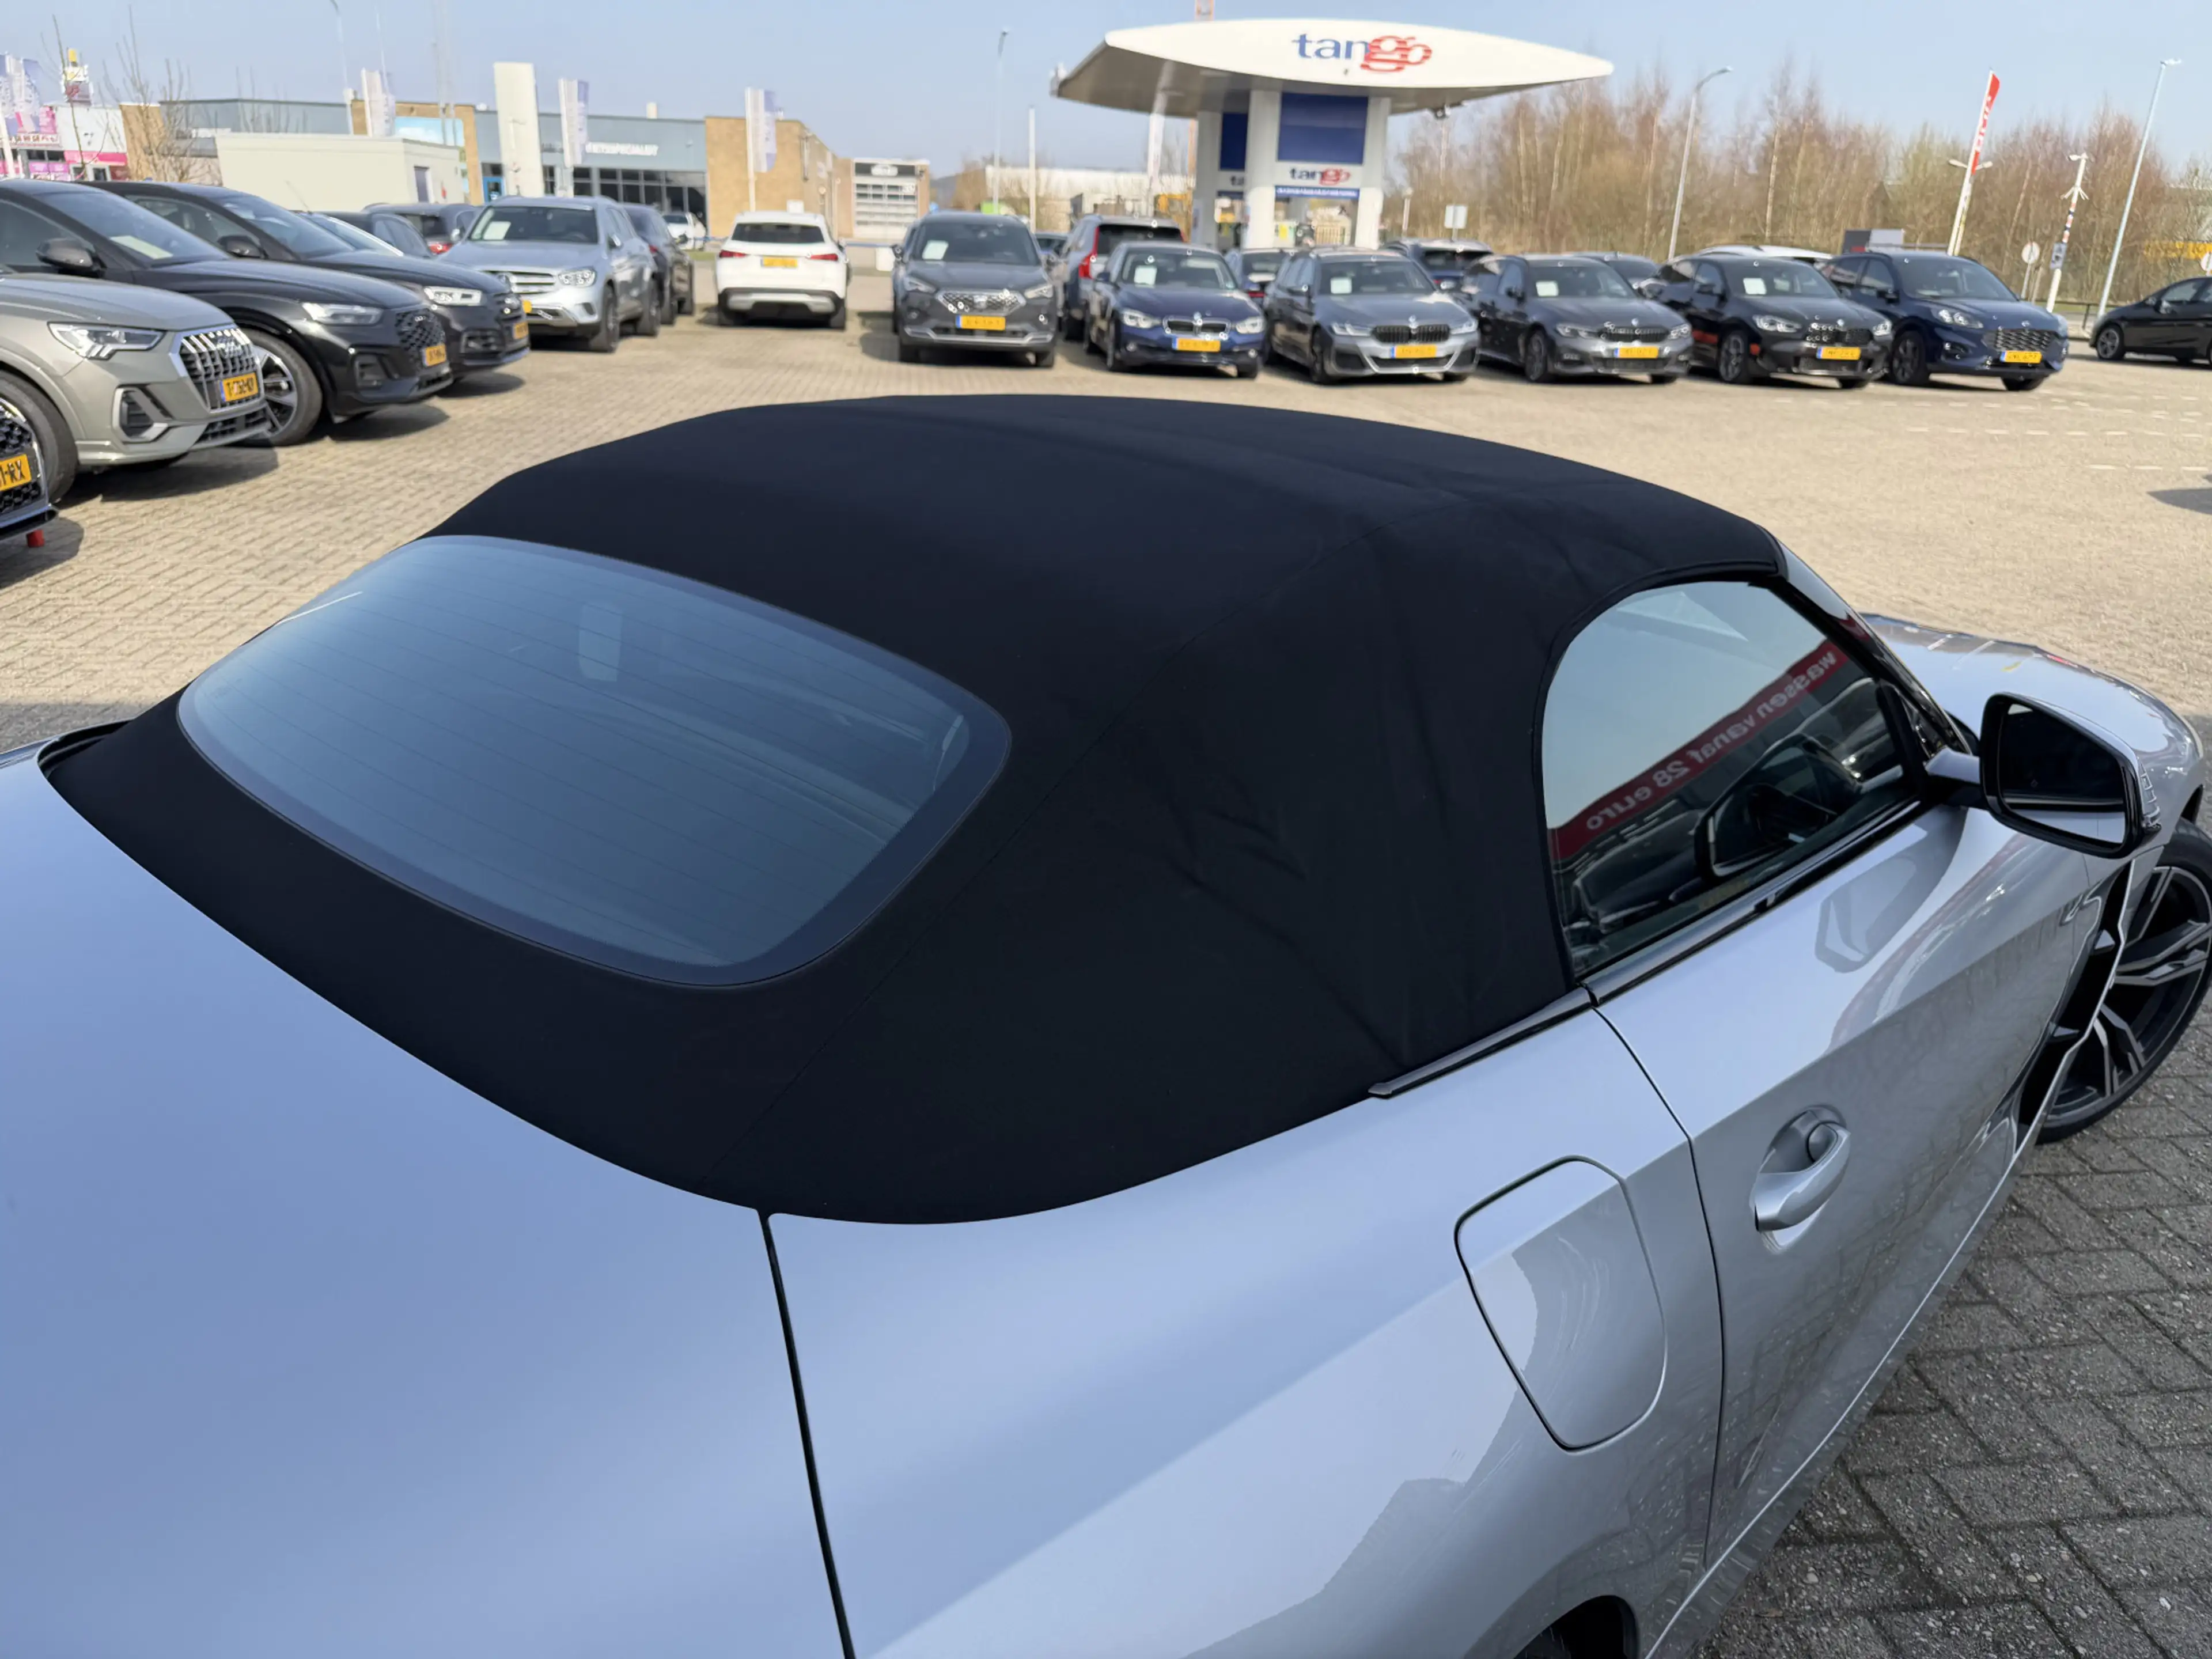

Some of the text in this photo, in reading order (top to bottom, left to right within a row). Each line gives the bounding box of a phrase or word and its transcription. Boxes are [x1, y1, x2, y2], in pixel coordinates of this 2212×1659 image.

[1291, 33, 1432, 73] tango
[1229, 175, 1245, 187] ta
[1290, 167, 1351, 185] tango
